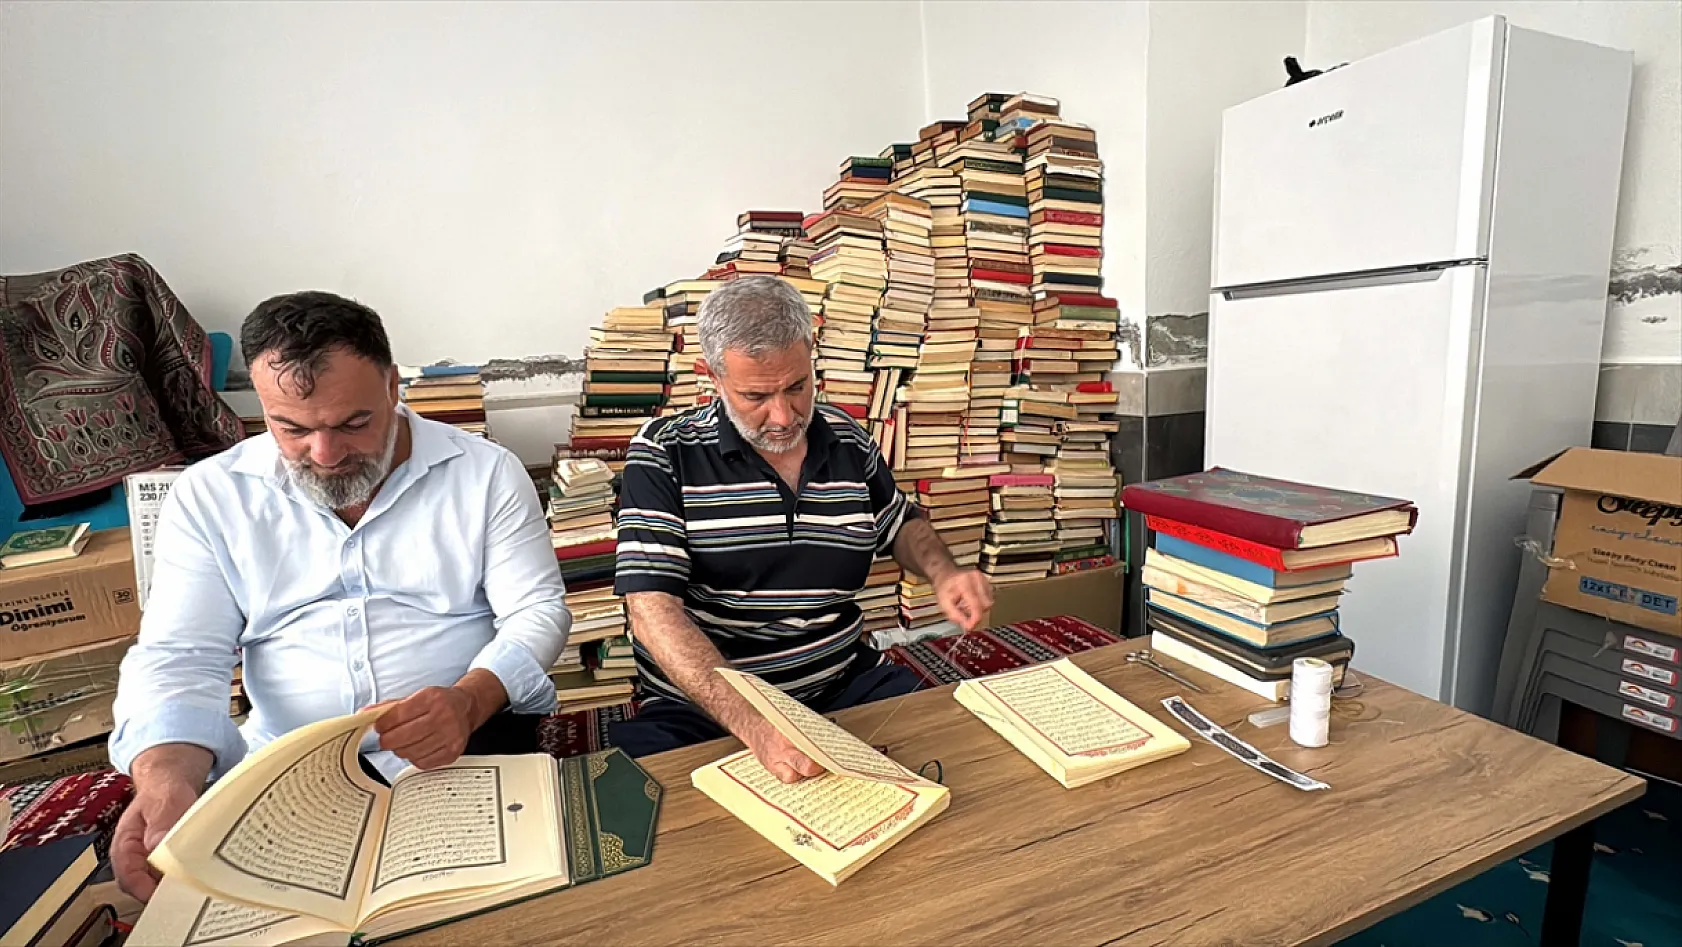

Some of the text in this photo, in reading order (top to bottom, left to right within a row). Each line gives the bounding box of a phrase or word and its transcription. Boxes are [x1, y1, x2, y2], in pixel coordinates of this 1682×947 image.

[139, 482, 173, 491] MS 21
[140, 492, 156, 501] 230
[1648, 559, 1676, 571] Clean
[0, 598, 74, 625] Dinimi
